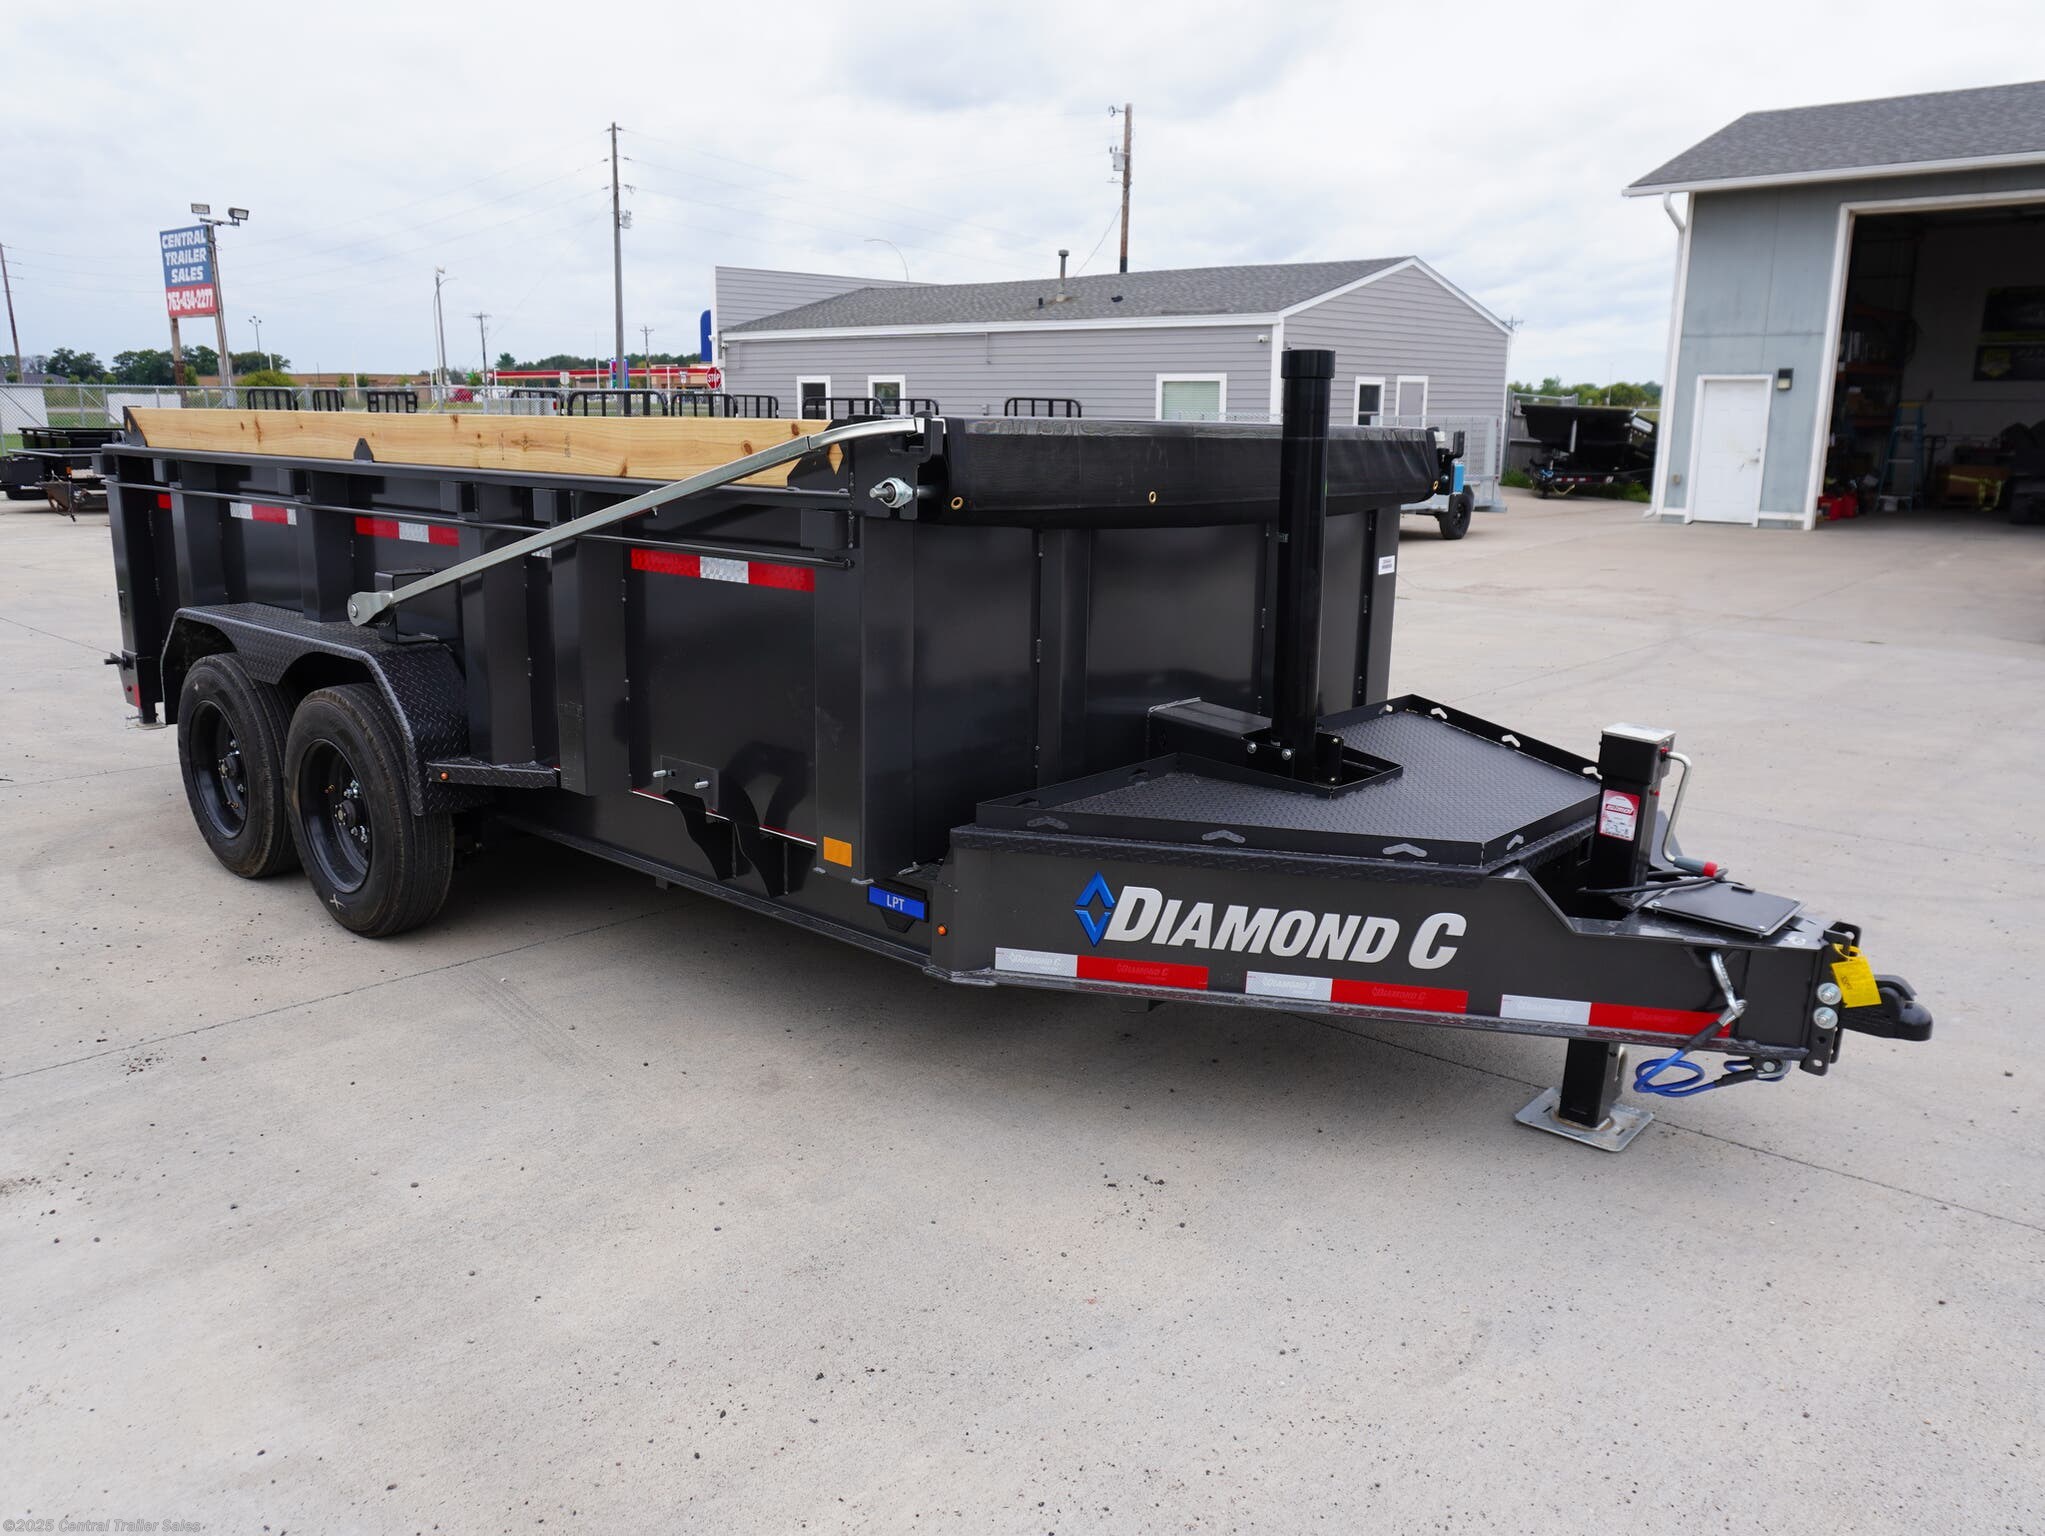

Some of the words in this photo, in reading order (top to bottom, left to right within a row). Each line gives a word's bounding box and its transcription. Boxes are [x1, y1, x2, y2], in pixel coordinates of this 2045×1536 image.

[162, 229, 206, 249] CENTRAL
[165, 247, 207, 266] TRAILER
[171, 266, 204, 283] SALES
[707, 373, 721, 383] STOP
[886, 894, 905, 911] LPT
[1103, 885, 1400, 964] DIAMOND
[1408, 912, 1467, 970] C
